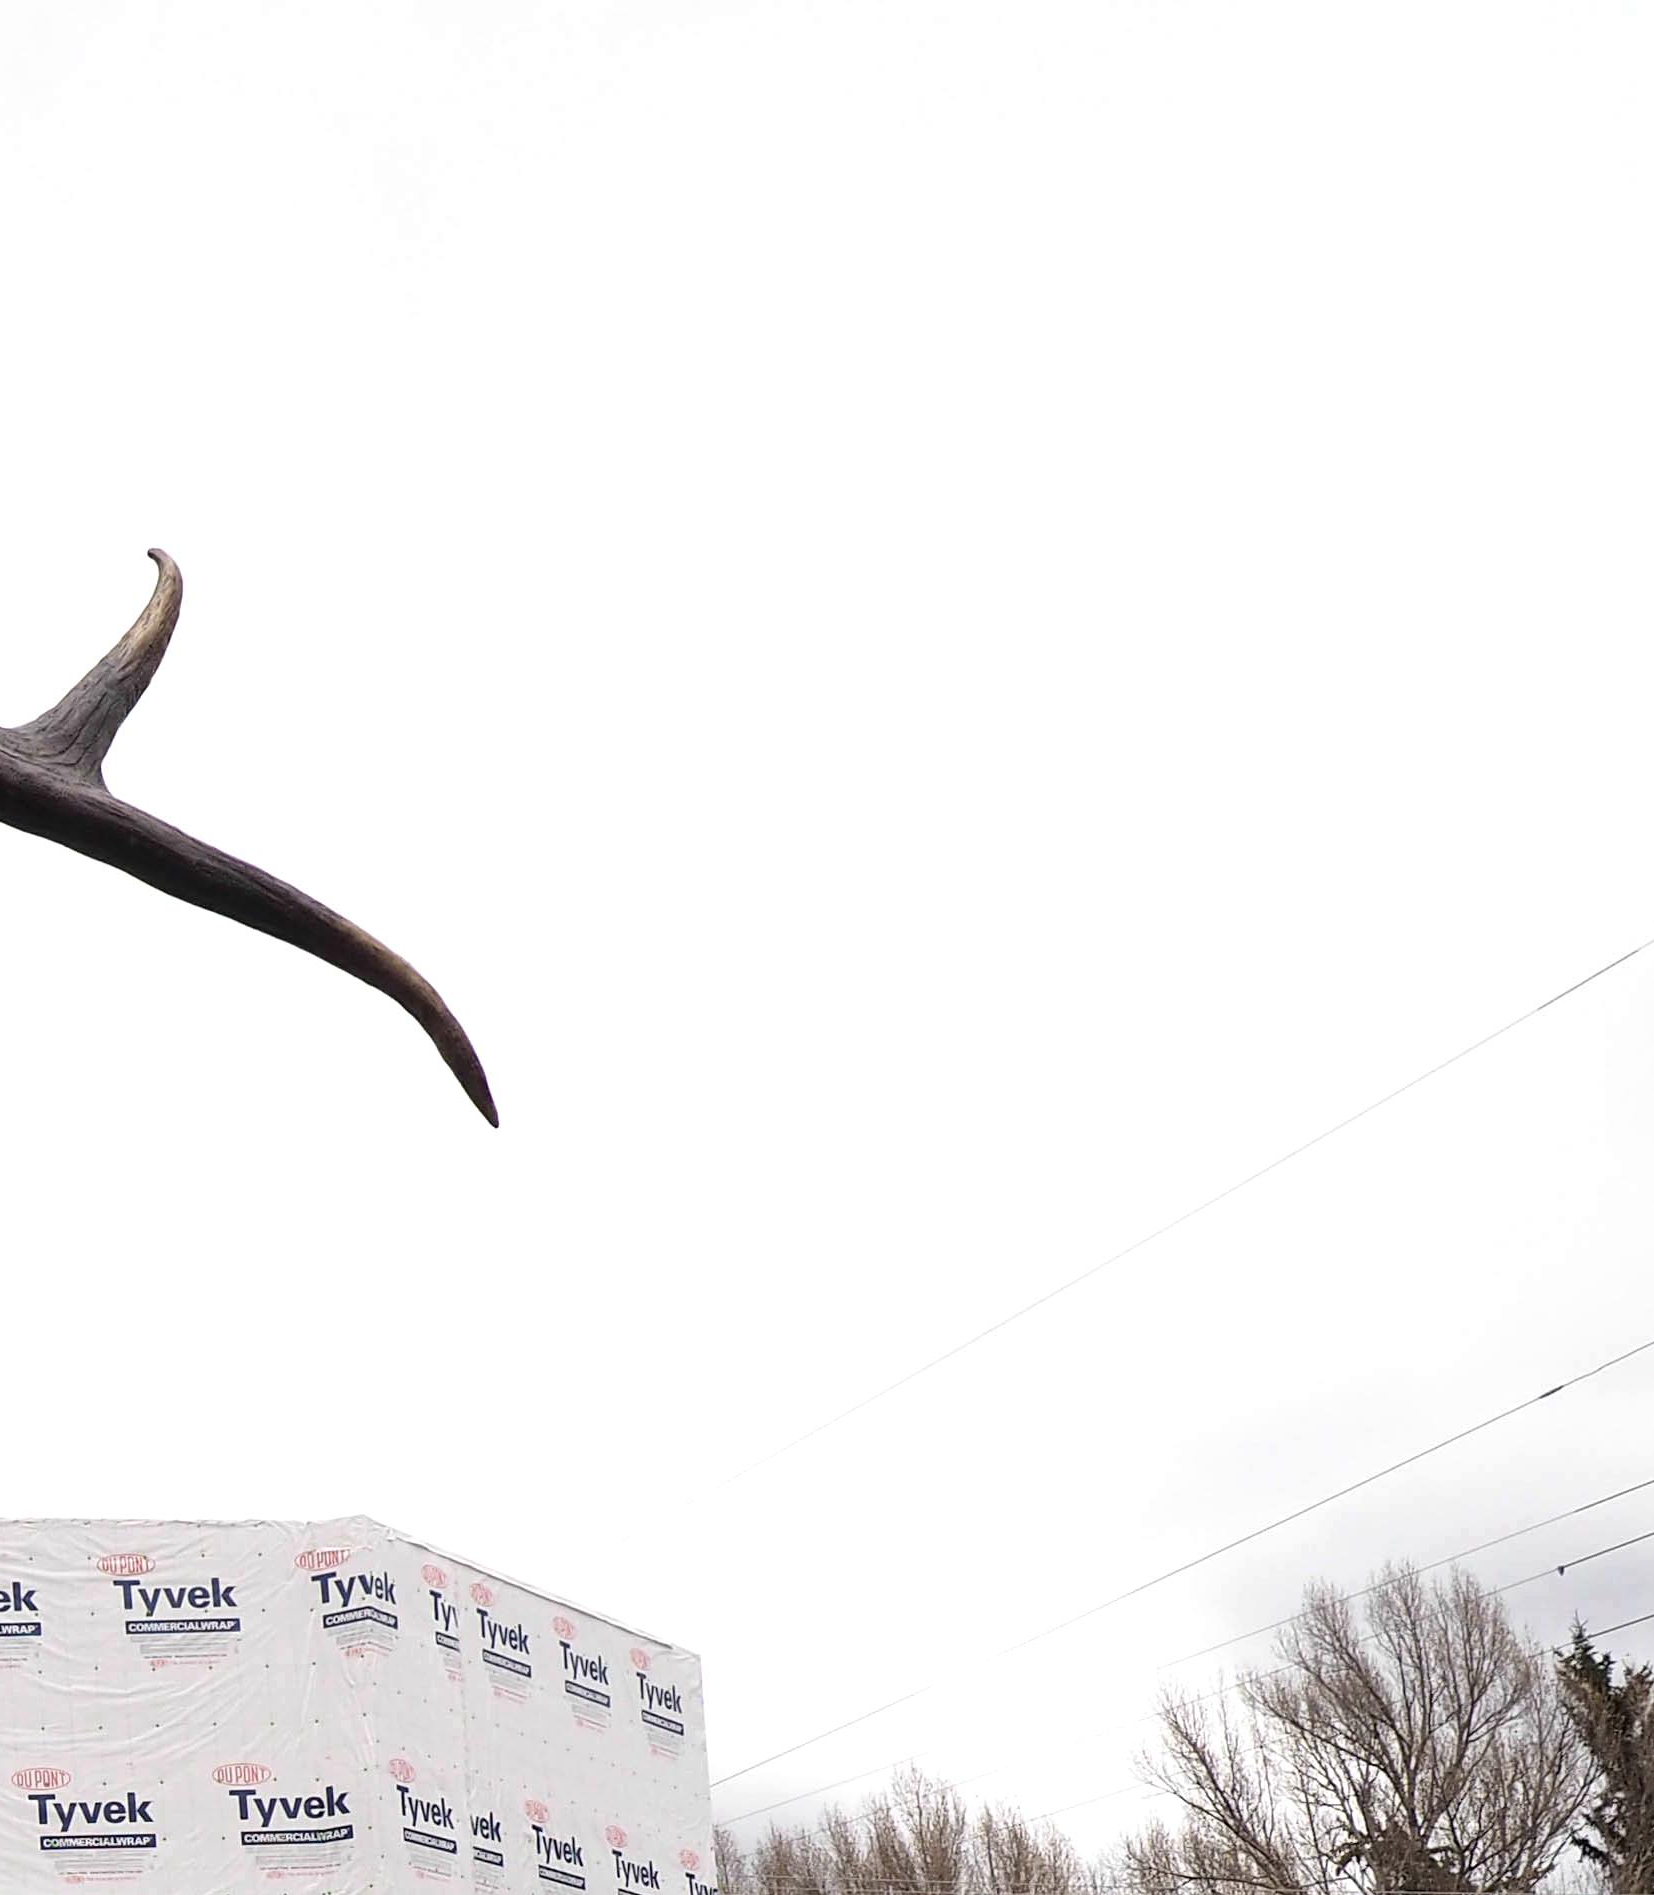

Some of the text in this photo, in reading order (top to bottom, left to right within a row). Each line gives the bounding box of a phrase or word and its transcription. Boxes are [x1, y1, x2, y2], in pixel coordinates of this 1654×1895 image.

[114, 1578, 237, 1616] Tyvek
[311, 1571, 396, 1607] Tyvek
[129, 1621, 236, 1632] COMMERCIALWRAP
[476, 1608, 530, 1654] Tyvek
[559, 1640, 609, 1685] Tyvek
[636, 1672, 682, 1714] Tyvek
[28, 1792, 153, 1832] Tyvek
[229, 1786, 350, 1827] Tyvek
[396, 1784, 454, 1830] Tyvek
[470, 1811, 501, 1842] vek
[43, 1836, 150, 1847] COMMERCIALWRAP
[244, 1828, 349, 1843] COMMERCIALWRAP
[532, 1824, 583, 1867] Tyvek
[612, 1849, 660, 1889] Tyvek
